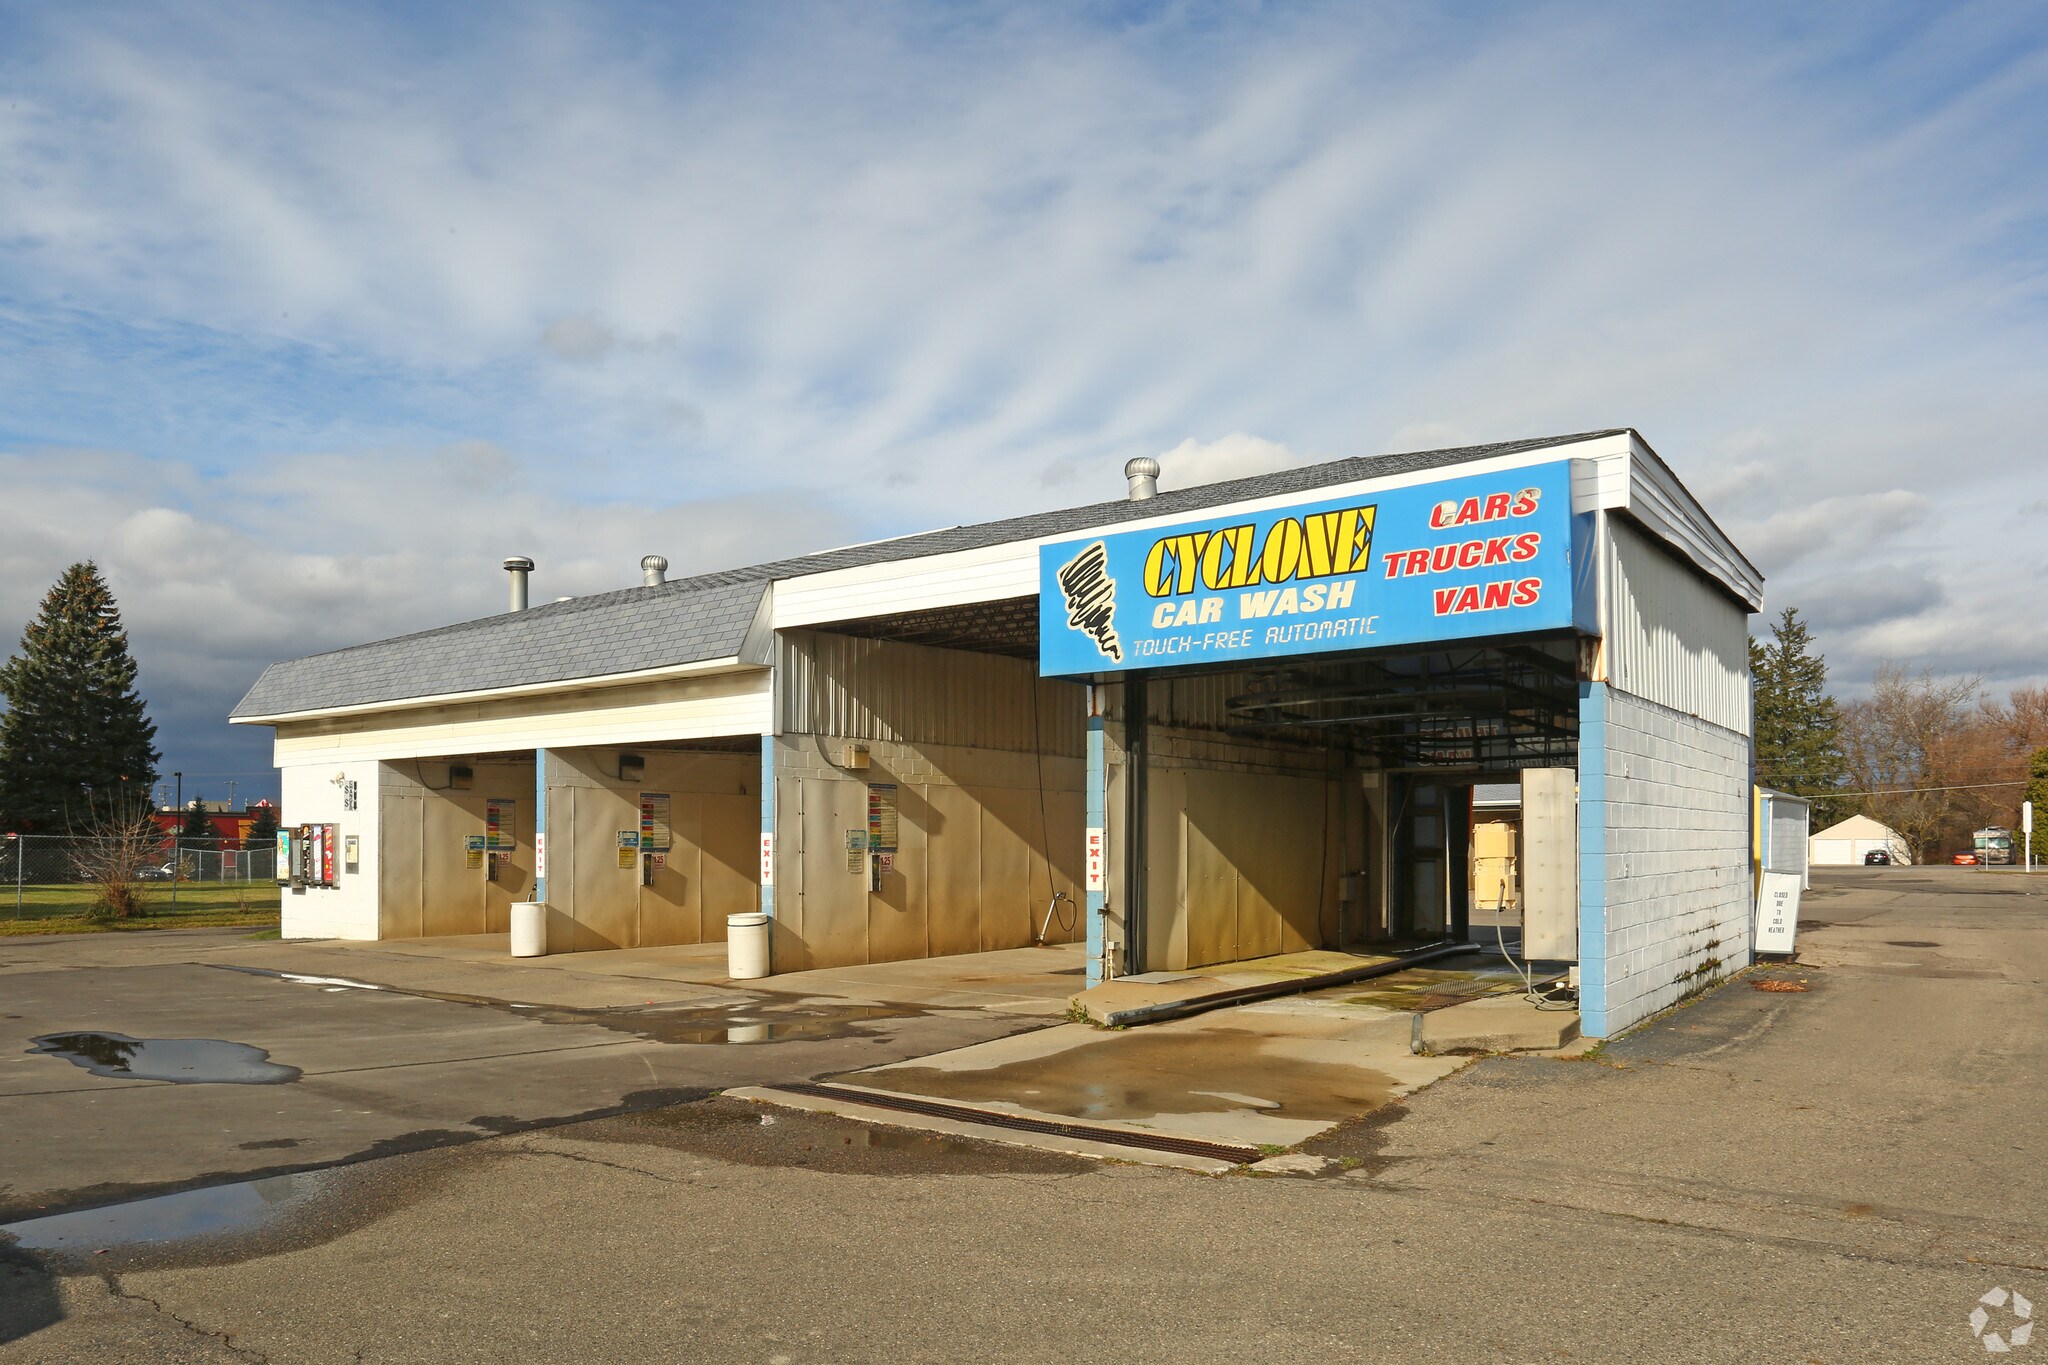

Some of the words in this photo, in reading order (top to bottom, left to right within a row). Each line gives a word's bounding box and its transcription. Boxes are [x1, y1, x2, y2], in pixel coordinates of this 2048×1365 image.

[1429, 487, 1541, 530] CARS
[1143, 504, 1378, 598] CYCLONE
[1382, 532, 1541, 580] TRUCKS
[1151, 597, 1224, 629] CAR
[1240, 580, 1356, 620] WASH
[1433, 577, 1542, 616] VANS
[1133, 629, 1254, 657] TOUCH-FREE
[1265, 615, 1379, 645] AUTOMATIC
[763, 840, 771, 878] EXIT
[1090, 836, 1100, 883] EXIT
